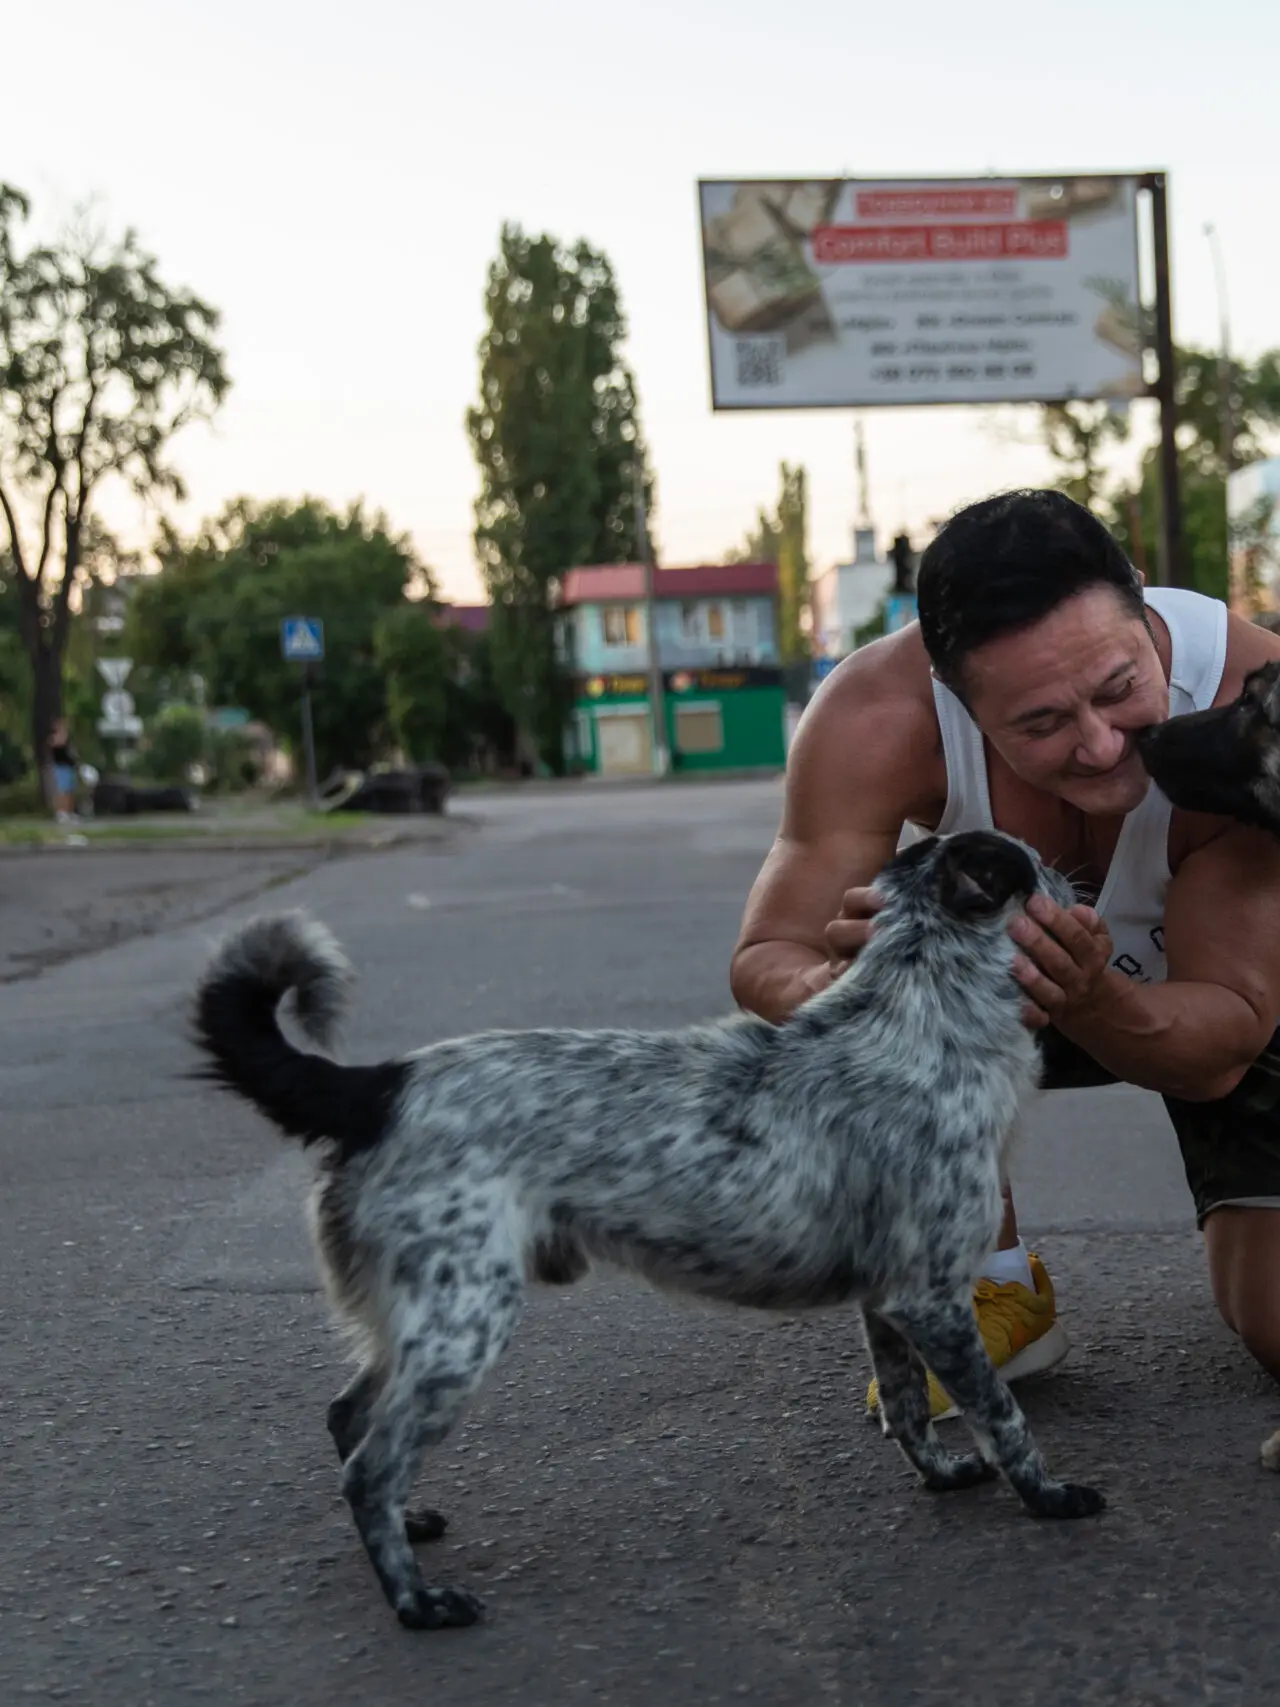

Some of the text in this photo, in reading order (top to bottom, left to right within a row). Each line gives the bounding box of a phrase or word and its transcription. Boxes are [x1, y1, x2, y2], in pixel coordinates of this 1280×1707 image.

[819, 225, 1062, 257] Comfort Build Plus
